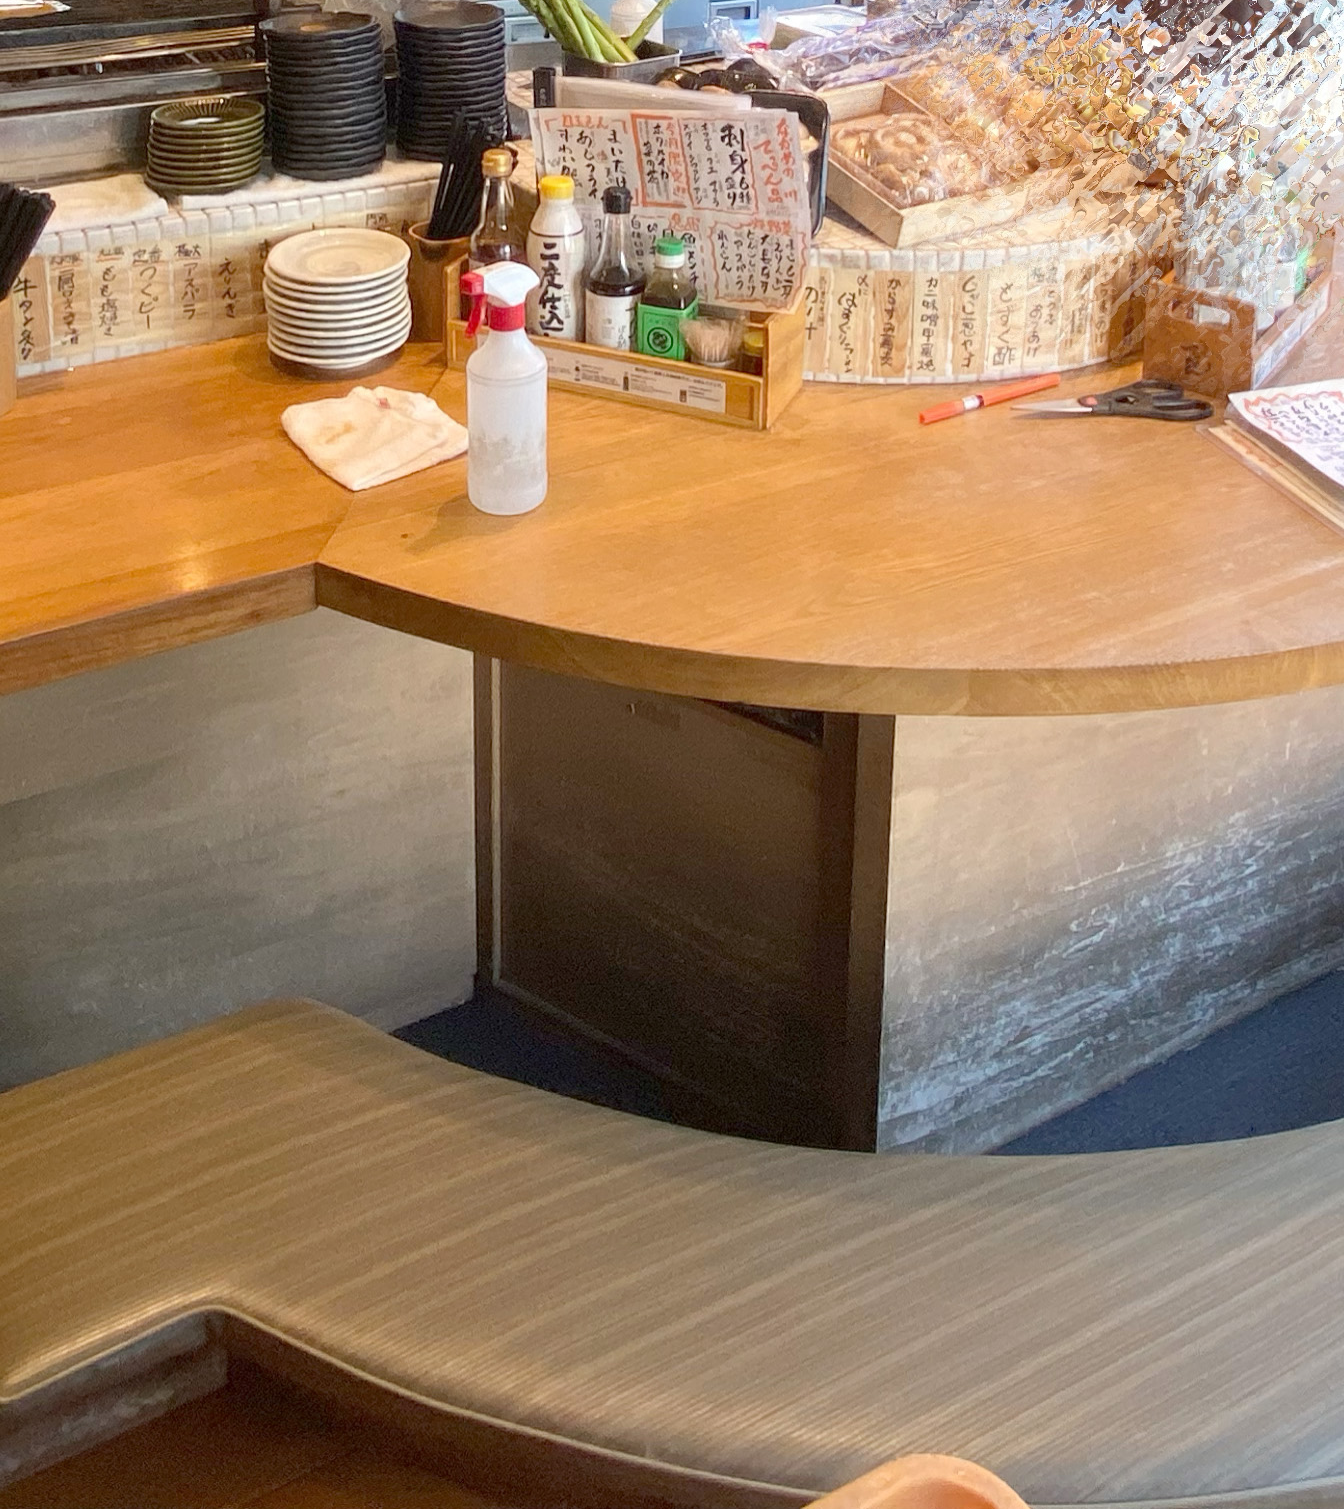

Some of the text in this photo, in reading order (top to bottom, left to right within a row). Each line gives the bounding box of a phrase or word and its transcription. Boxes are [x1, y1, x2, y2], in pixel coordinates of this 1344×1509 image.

[720, 123, 747, 174] 刺身
[138, 266, 160, 329] つくピー
[181, 263, 200, 320] アスパラ
[539, 242, 564, 339] 二度仕込
